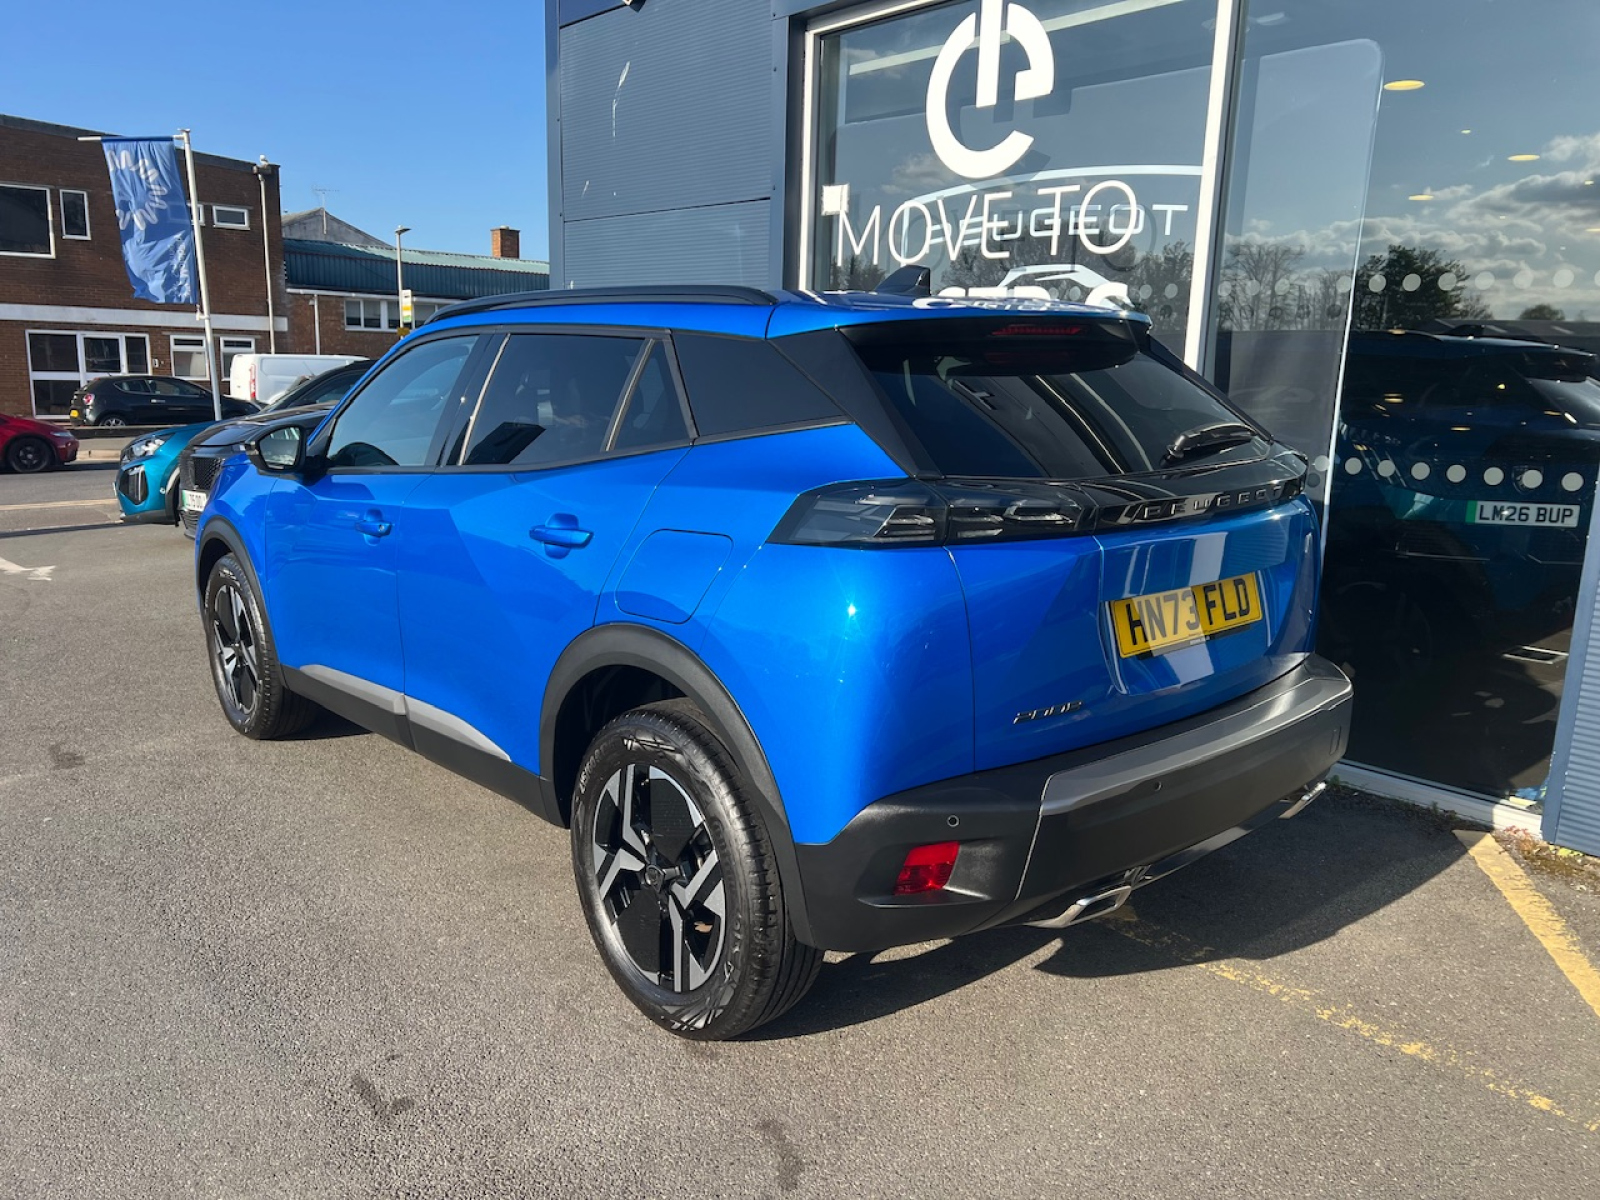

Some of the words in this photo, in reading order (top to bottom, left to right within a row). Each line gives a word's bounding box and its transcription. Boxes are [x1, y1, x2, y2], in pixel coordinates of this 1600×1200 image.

[836, 191, 1013, 267] MOVE
[1037, 179, 1137, 256] TO
[926, 203, 1189, 254] PEUGEOT
[1143, 485, 1283, 519] PEUGEOT
[1478, 503, 1530, 523] LM26
[1534, 506, 1575, 524] BUP
[1125, 589, 1201, 646] HN73
[1202, 577, 1251, 626] FLD
